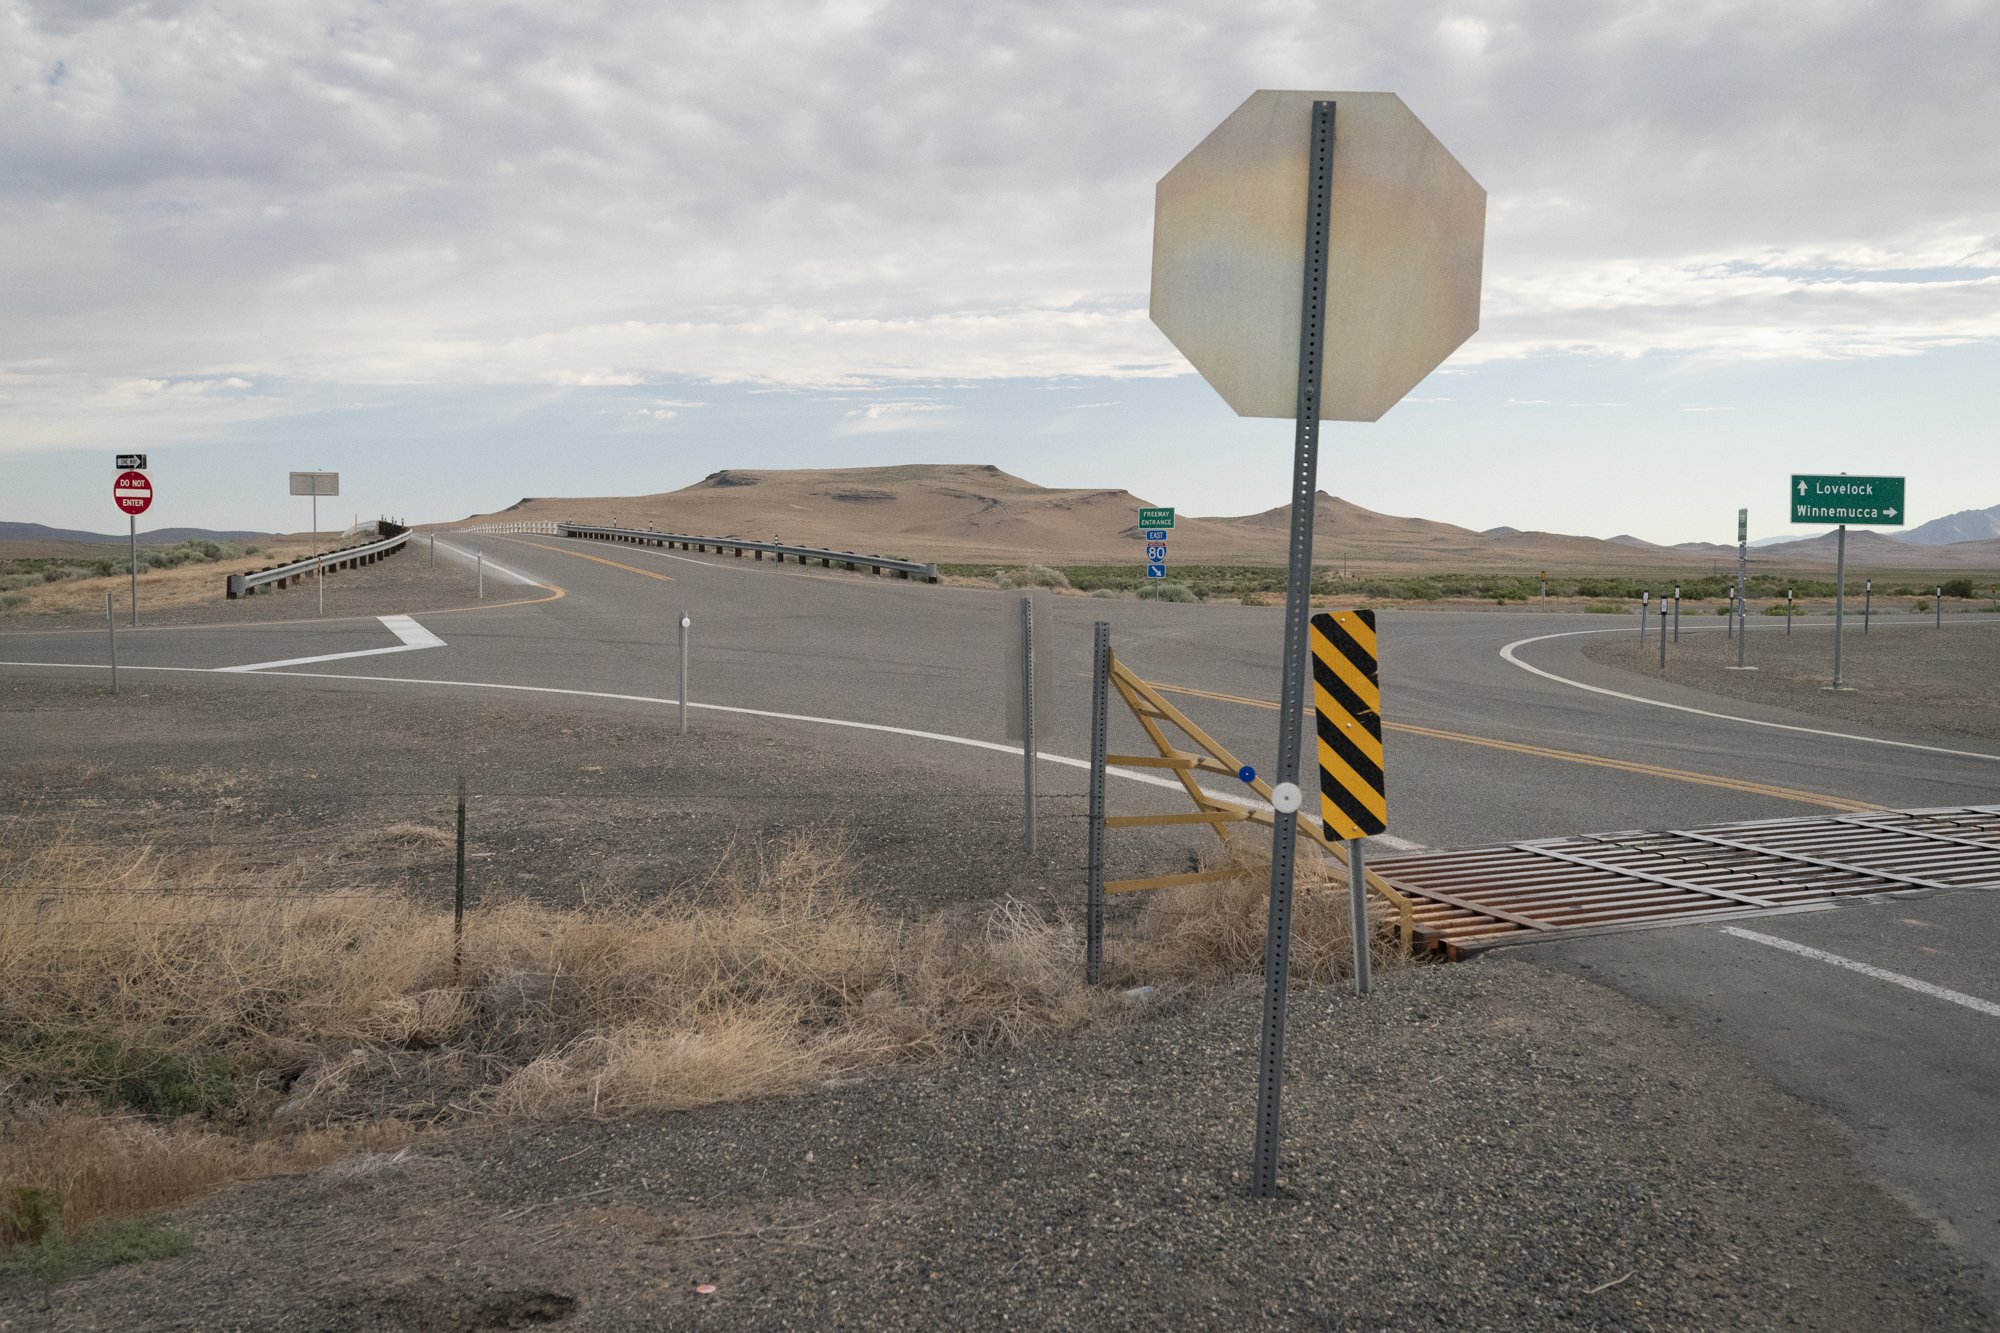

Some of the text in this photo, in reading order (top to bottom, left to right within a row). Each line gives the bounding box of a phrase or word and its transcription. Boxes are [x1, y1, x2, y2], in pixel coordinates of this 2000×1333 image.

[1816, 482, 1873, 495] Lovelock
[1797, 505, 1878, 517] Winnemucca
[1149, 547, 1164, 559] 80
